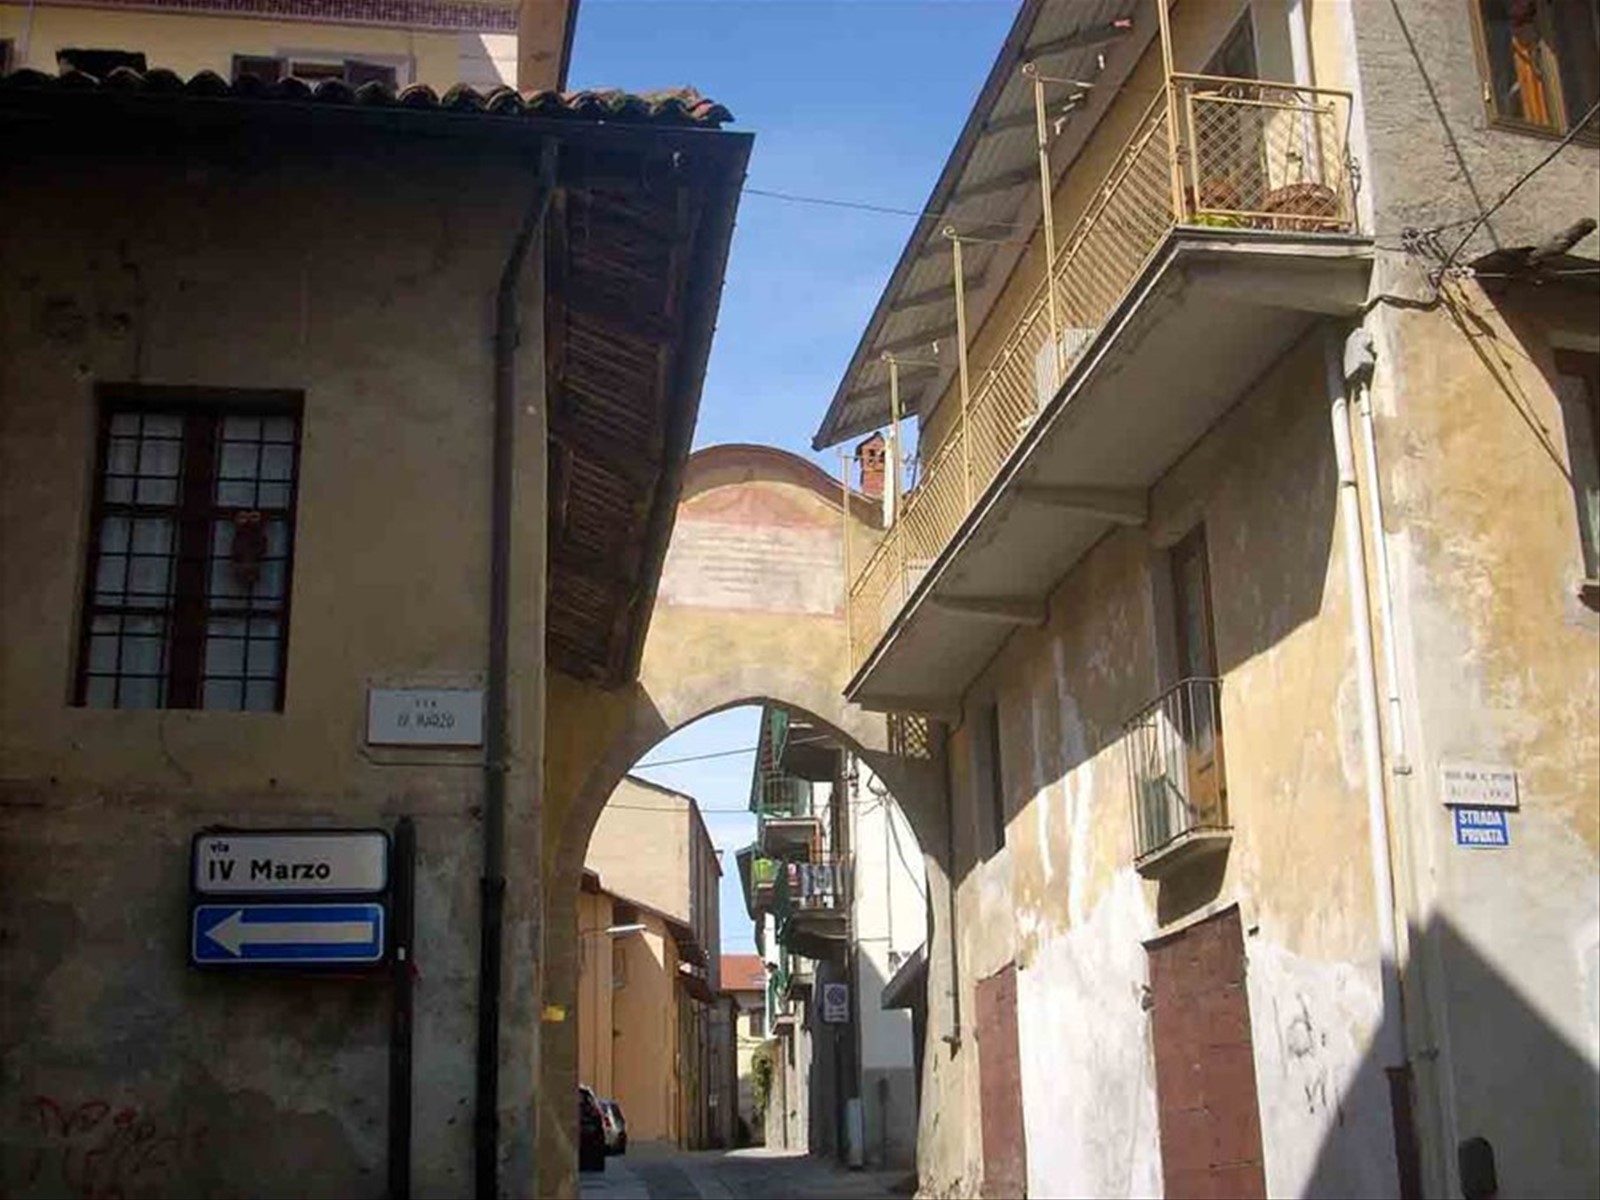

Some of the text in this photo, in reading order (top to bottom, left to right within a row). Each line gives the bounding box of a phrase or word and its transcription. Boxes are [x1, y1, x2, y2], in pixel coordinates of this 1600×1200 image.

[416, 713, 456, 728] MARZO
[1458, 810, 1503, 825] STRADA
[1460, 828, 1505, 843] PRIVATA
[210, 841, 229, 853] via
[208, 859, 331, 881] IV Marzo
